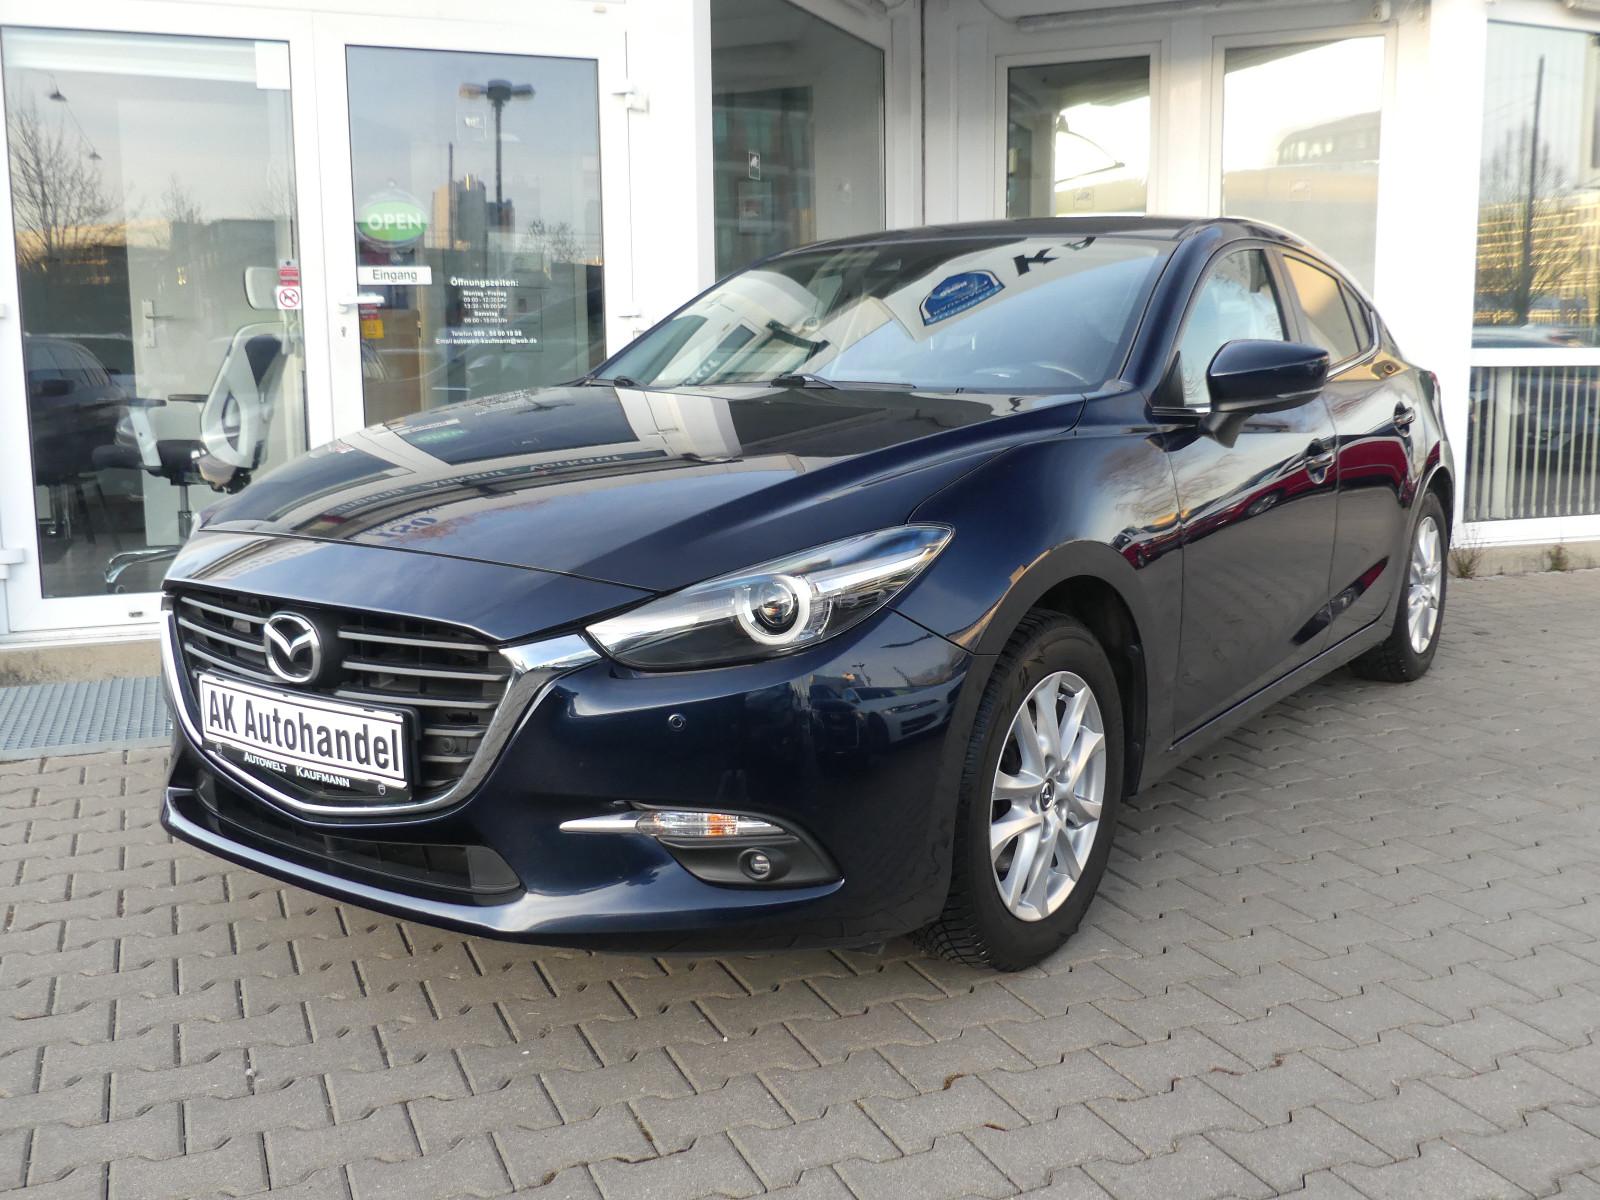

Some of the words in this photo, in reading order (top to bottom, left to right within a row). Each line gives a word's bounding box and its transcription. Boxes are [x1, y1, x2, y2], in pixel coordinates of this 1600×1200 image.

[368, 213, 422, 231] OPEN
[372, 269, 418, 283] Eingang
[450, 276, 519, 288] Öffnungszeiten:
[209, 690, 237, 734] AK
[245, 699, 400, 773] Autohandel
[244, 752, 287, 773] AUTOWELT
[295, 765, 350, 788] KAUFMANN
